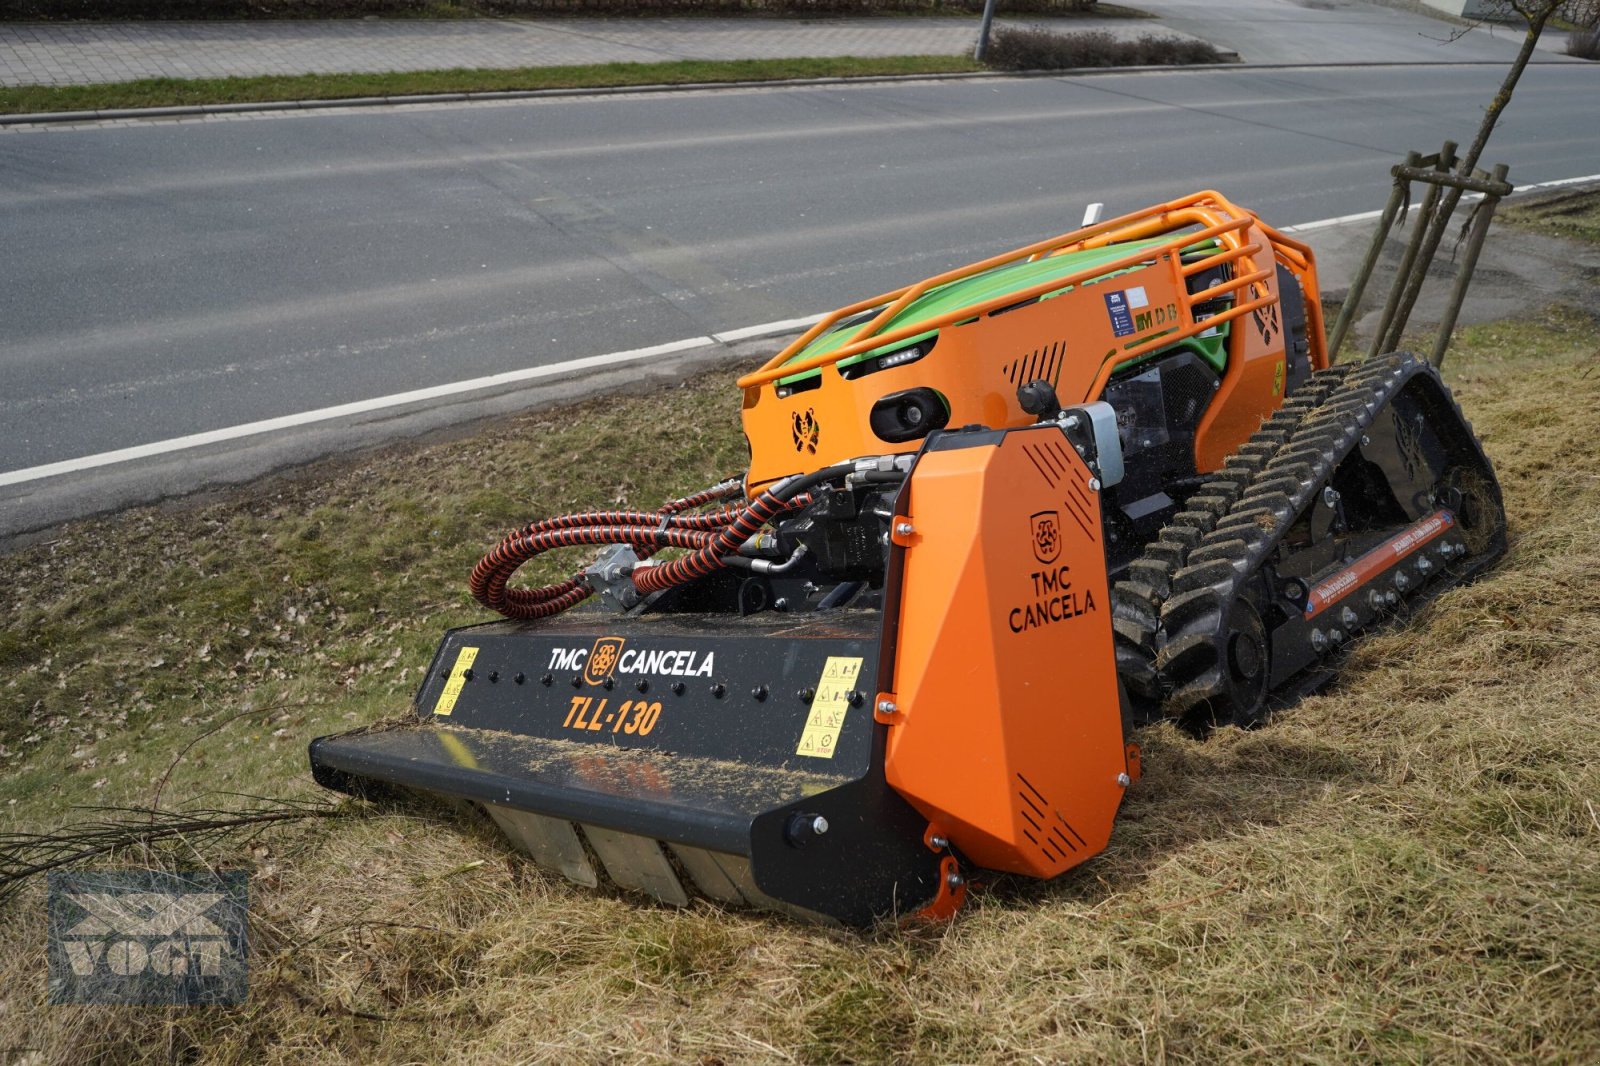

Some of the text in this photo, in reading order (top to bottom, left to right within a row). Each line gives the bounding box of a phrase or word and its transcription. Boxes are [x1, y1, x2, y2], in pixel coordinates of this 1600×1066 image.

[1135, 304, 1177, 332] MDB
[1031, 566, 1071, 597] TMC
[1009, 589, 1096, 634] CANCELA
[548, 648, 714, 677] TMC CANCELA
